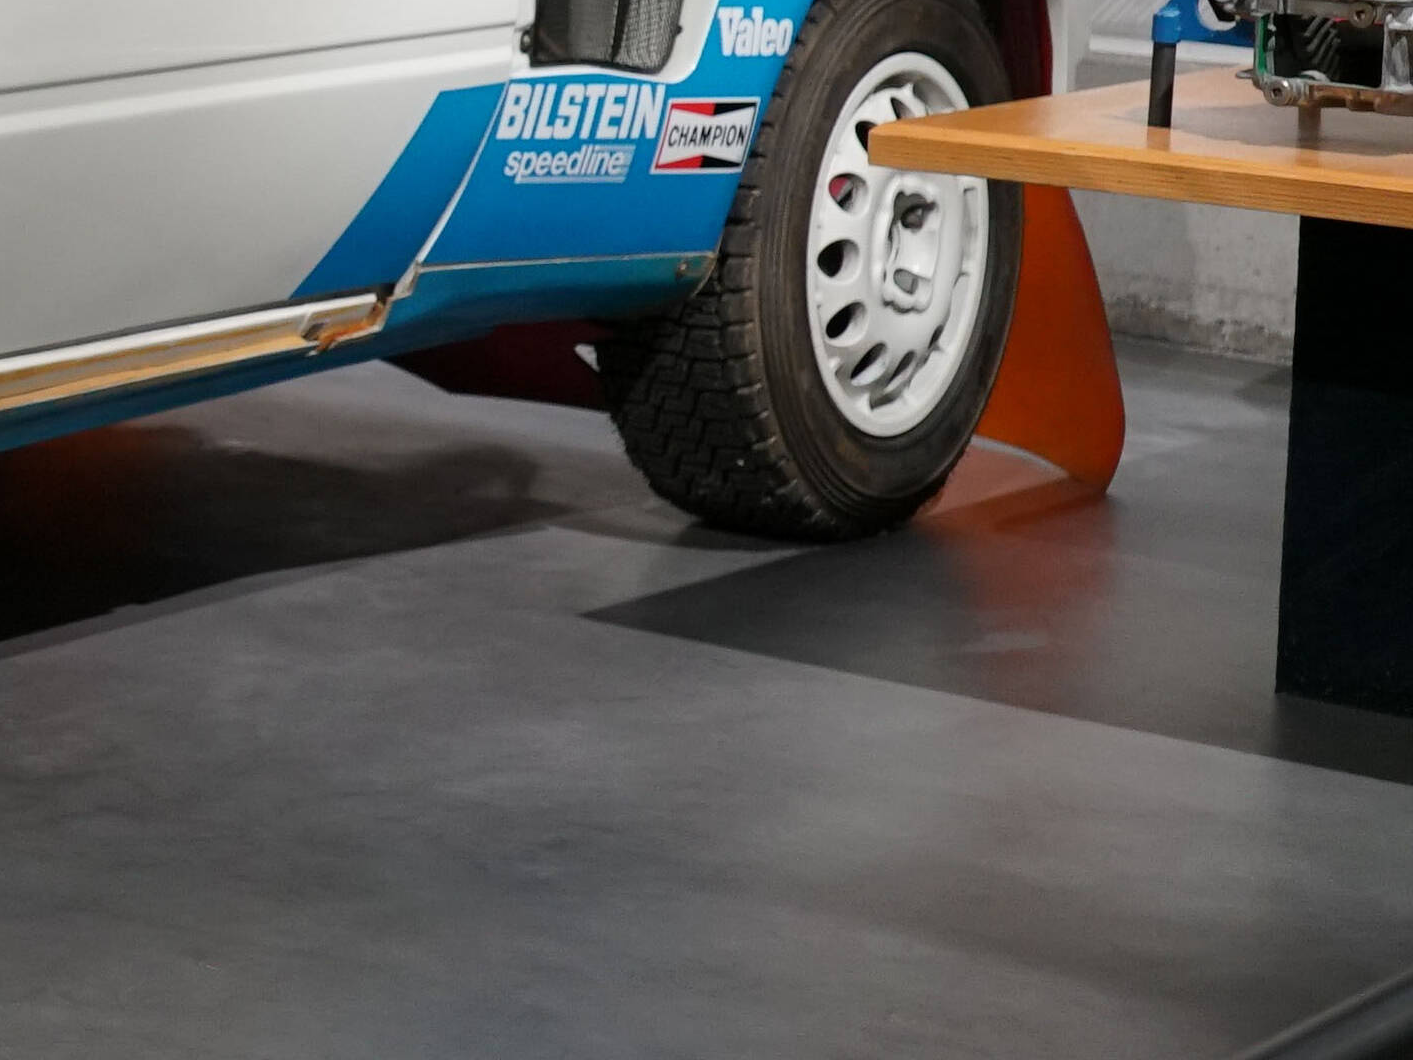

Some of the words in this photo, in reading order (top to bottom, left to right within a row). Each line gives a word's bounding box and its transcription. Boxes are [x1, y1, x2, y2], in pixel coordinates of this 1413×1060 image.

[718, 6, 794, 57] Valeo
[496, 82, 666, 141] BILSTEIN
[668, 124, 750, 148] CHAMPION
[504, 144, 628, 181] speedline
